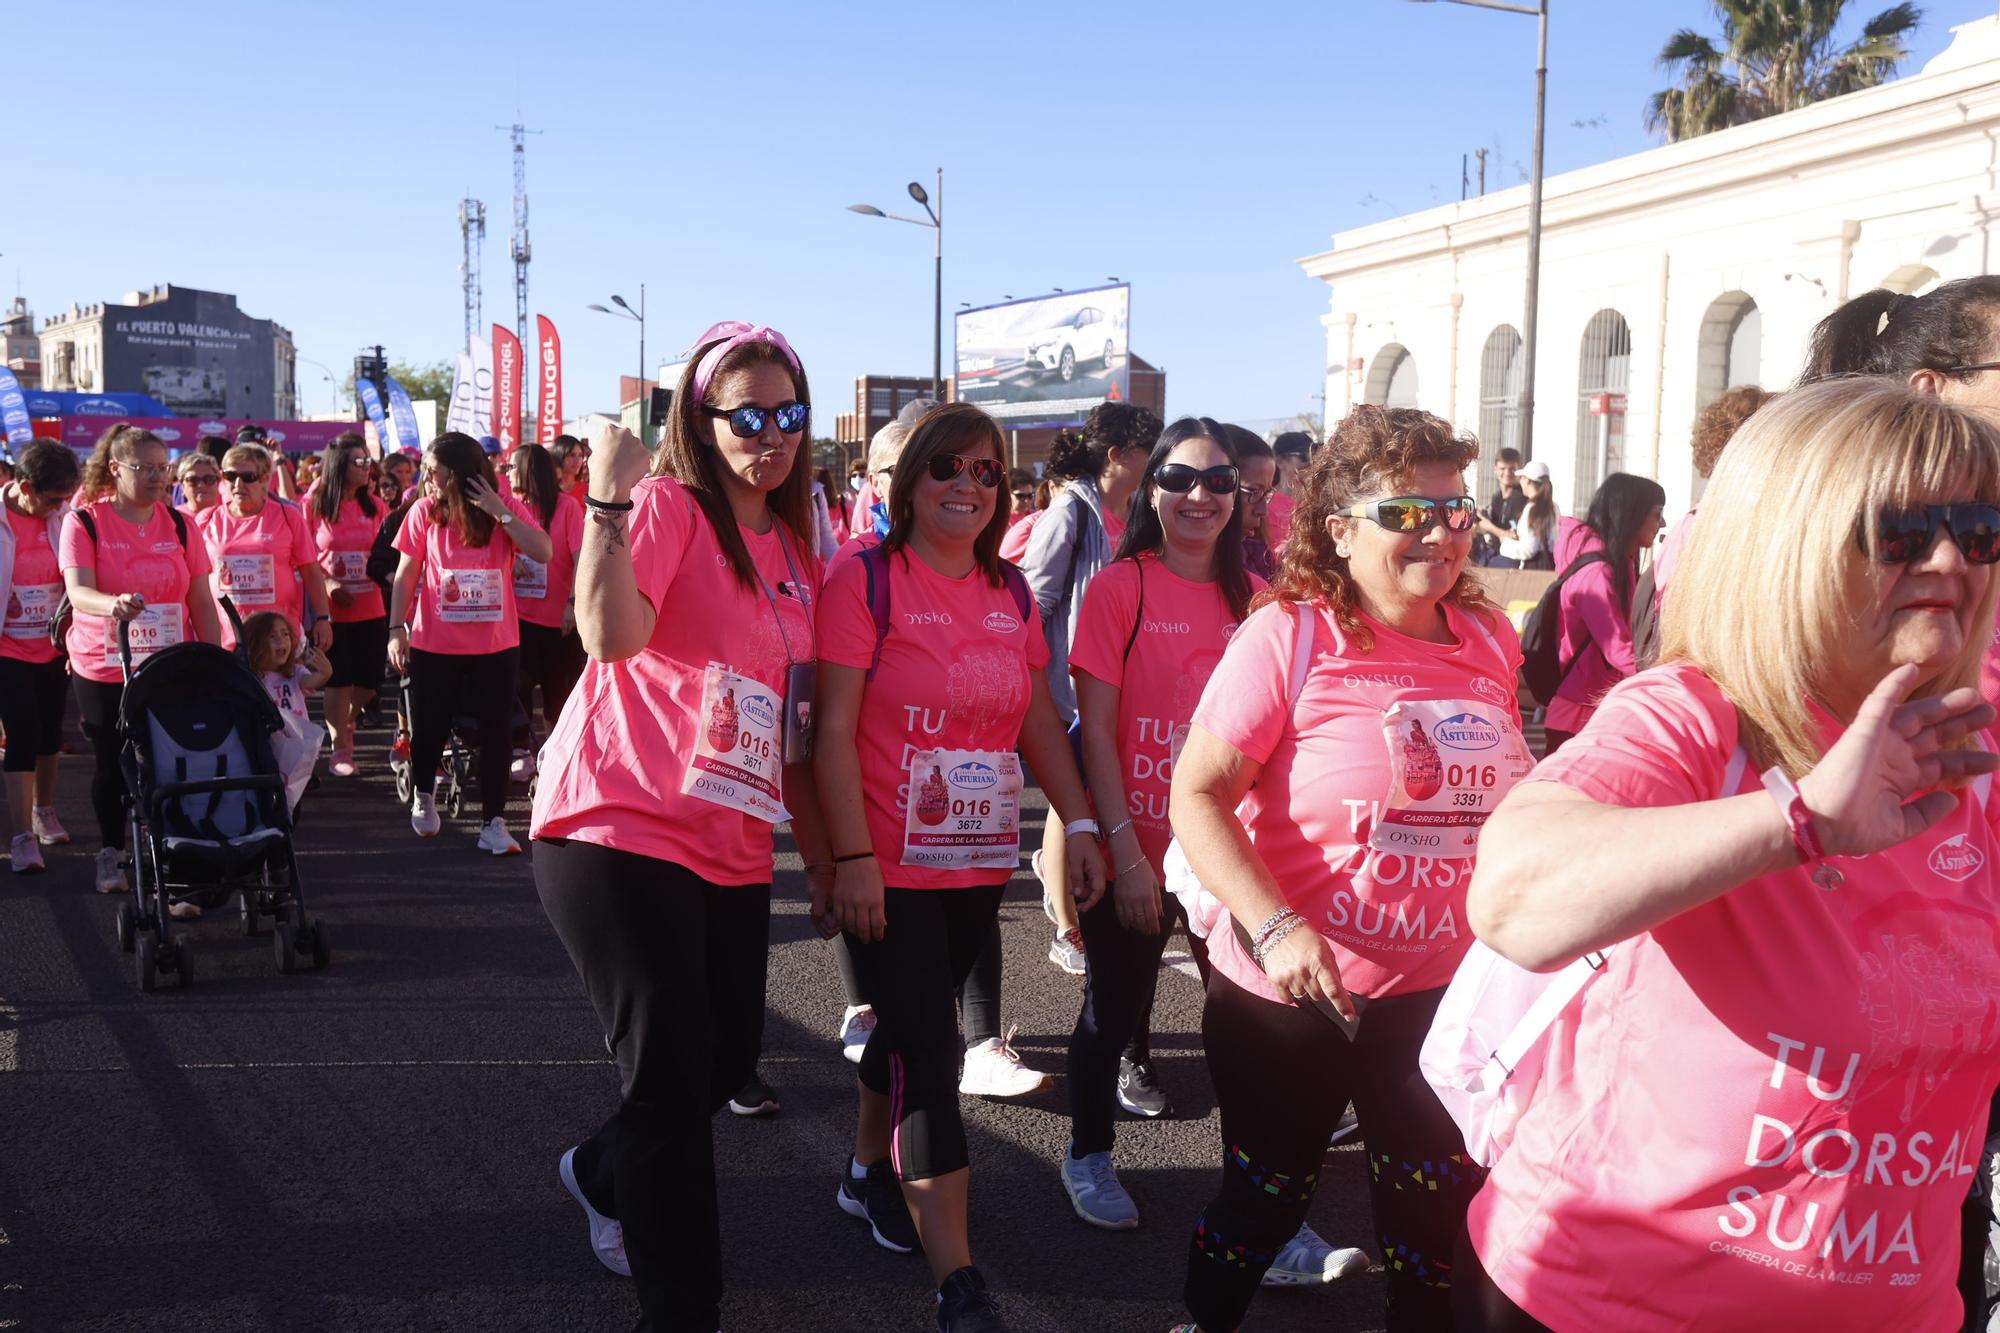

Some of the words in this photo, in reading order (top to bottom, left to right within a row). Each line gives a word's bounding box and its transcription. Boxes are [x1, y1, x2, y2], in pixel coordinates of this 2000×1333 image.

[116, 322, 129, 332] EL
[131, 320, 175, 336] PUERTO
[462, 590, 483, 599] 016
[131, 628, 157, 638] 016
[1143, 620, 1190, 634] OYSHO
[1343, 673, 1416, 689] OYSHO
[904, 704, 946, 734] TU
[1137, 717, 1174, 745] TU
[1440, 727, 1497, 742] ASTURIANA
[740, 731, 770, 758] 016
[742, 754, 762, 772] 3671
[705, 761, 739, 778] CARRERA
[739, 772, 749, 782] DE
[749, 776, 756, 785] LA
[953, 771, 994, 784] ASTURIANA
[1447, 764, 1496, 787] 016
[695, 776, 735, 798] OYSHO
[952, 799, 991, 816] 016
[1129, 790, 1168, 820] SU
[1452, 793, 1484, 806] 3391
[957, 820, 982, 830] 3672
[1403, 814, 1445, 824] CARRERA
[1447, 815, 1457, 824] DE
[1459, 815, 1470, 823] LA
[921, 836, 954, 844] CARRERA
[976, 836, 997, 844] MUJER
[1389, 831, 1441, 847] OYSHO
[915, 852, 954, 862] OYSHO
[980, 849, 1012, 860] Santander
[1342, 847, 1474, 888] DORSA
[1327, 891, 1458, 940] SUMA
[1322, 927, 1366, 947] CARRERA
[1365, 940, 1380, 950] DE
[1382, 942, 1395, 952] LA
[1396, 944, 1428, 953] MUJER
[1767, 1032, 1861, 1101] TU
[1744, 1113, 1974, 1187] DORSAL
[1717, 1185, 1920, 1265] SUMA
[1708, 1241, 1780, 1270] CARRERA
[1783, 1260, 1807, 1277] DE
[1806, 1265, 1825, 1280] LA
[1829, 1272, 1873, 1285] MUJER
